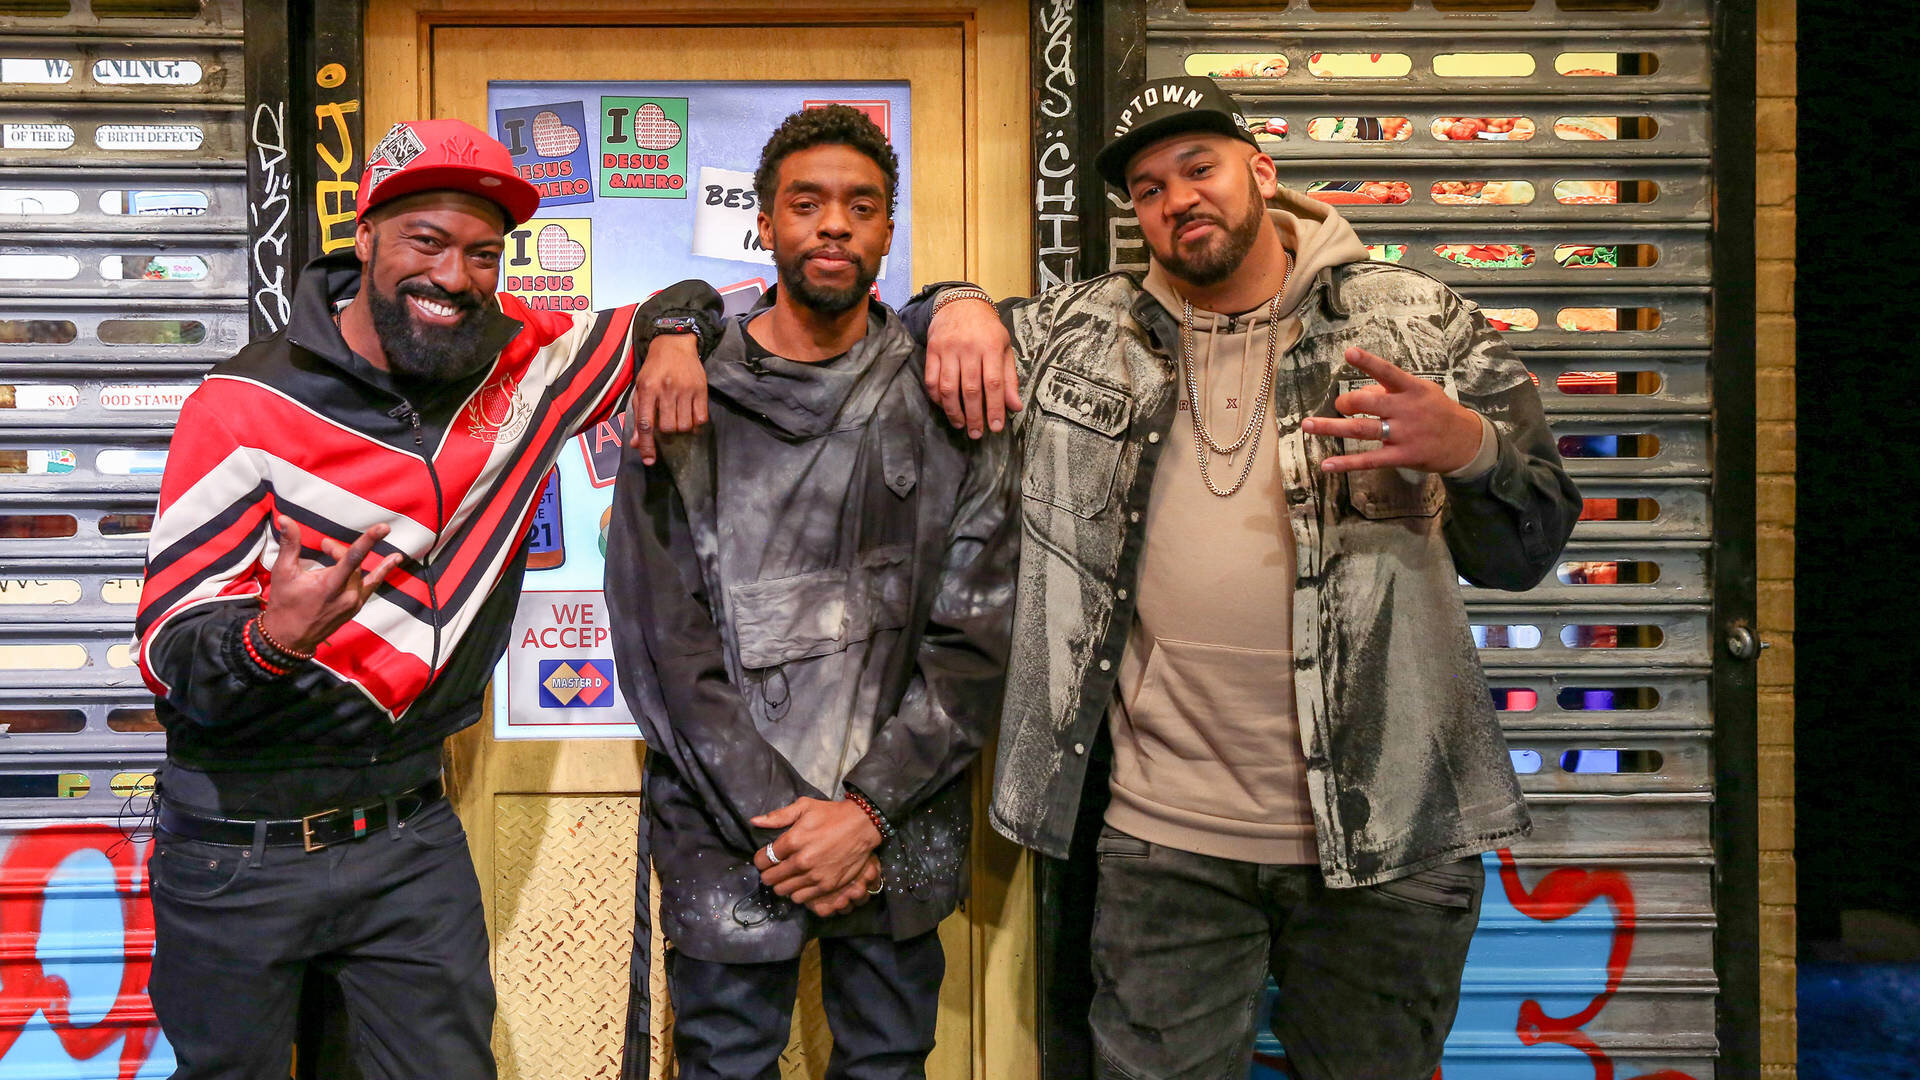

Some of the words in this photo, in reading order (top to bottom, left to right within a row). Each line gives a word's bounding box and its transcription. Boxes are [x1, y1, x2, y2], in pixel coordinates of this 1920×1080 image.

[44, 59, 180, 78] WNING:
[1114, 85, 1204, 137] UPTOWN
[11, 131, 28, 142] OF
[31, 131, 55, 142] THE
[58, 131, 75, 142] RIS
[95, 131, 104, 142] F
[108, 131, 145, 142] BIRTH
[148, 131, 203, 142] DEFECTS
[606, 108, 629, 144] I
[504, 119, 528, 156] I
[603, 153, 669, 170] DESUS
[533, 178, 590, 199] MERO
[609, 173, 684, 190] &MERO
[705, 184, 758, 210] BES
[510, 230, 532, 266] I
[506, 276, 574, 292] DESUS
[48, 394, 80, 406] SNA
[100, 394, 130, 406] OOD
[1226, 398, 1238, 410] X
[529, 522, 552, 548] 21
[551, 603, 594, 625] WE
[521, 627, 612, 649] ACCEP
[551, 678, 592, 688] MASTER
[594, 678, 602, 687] D
